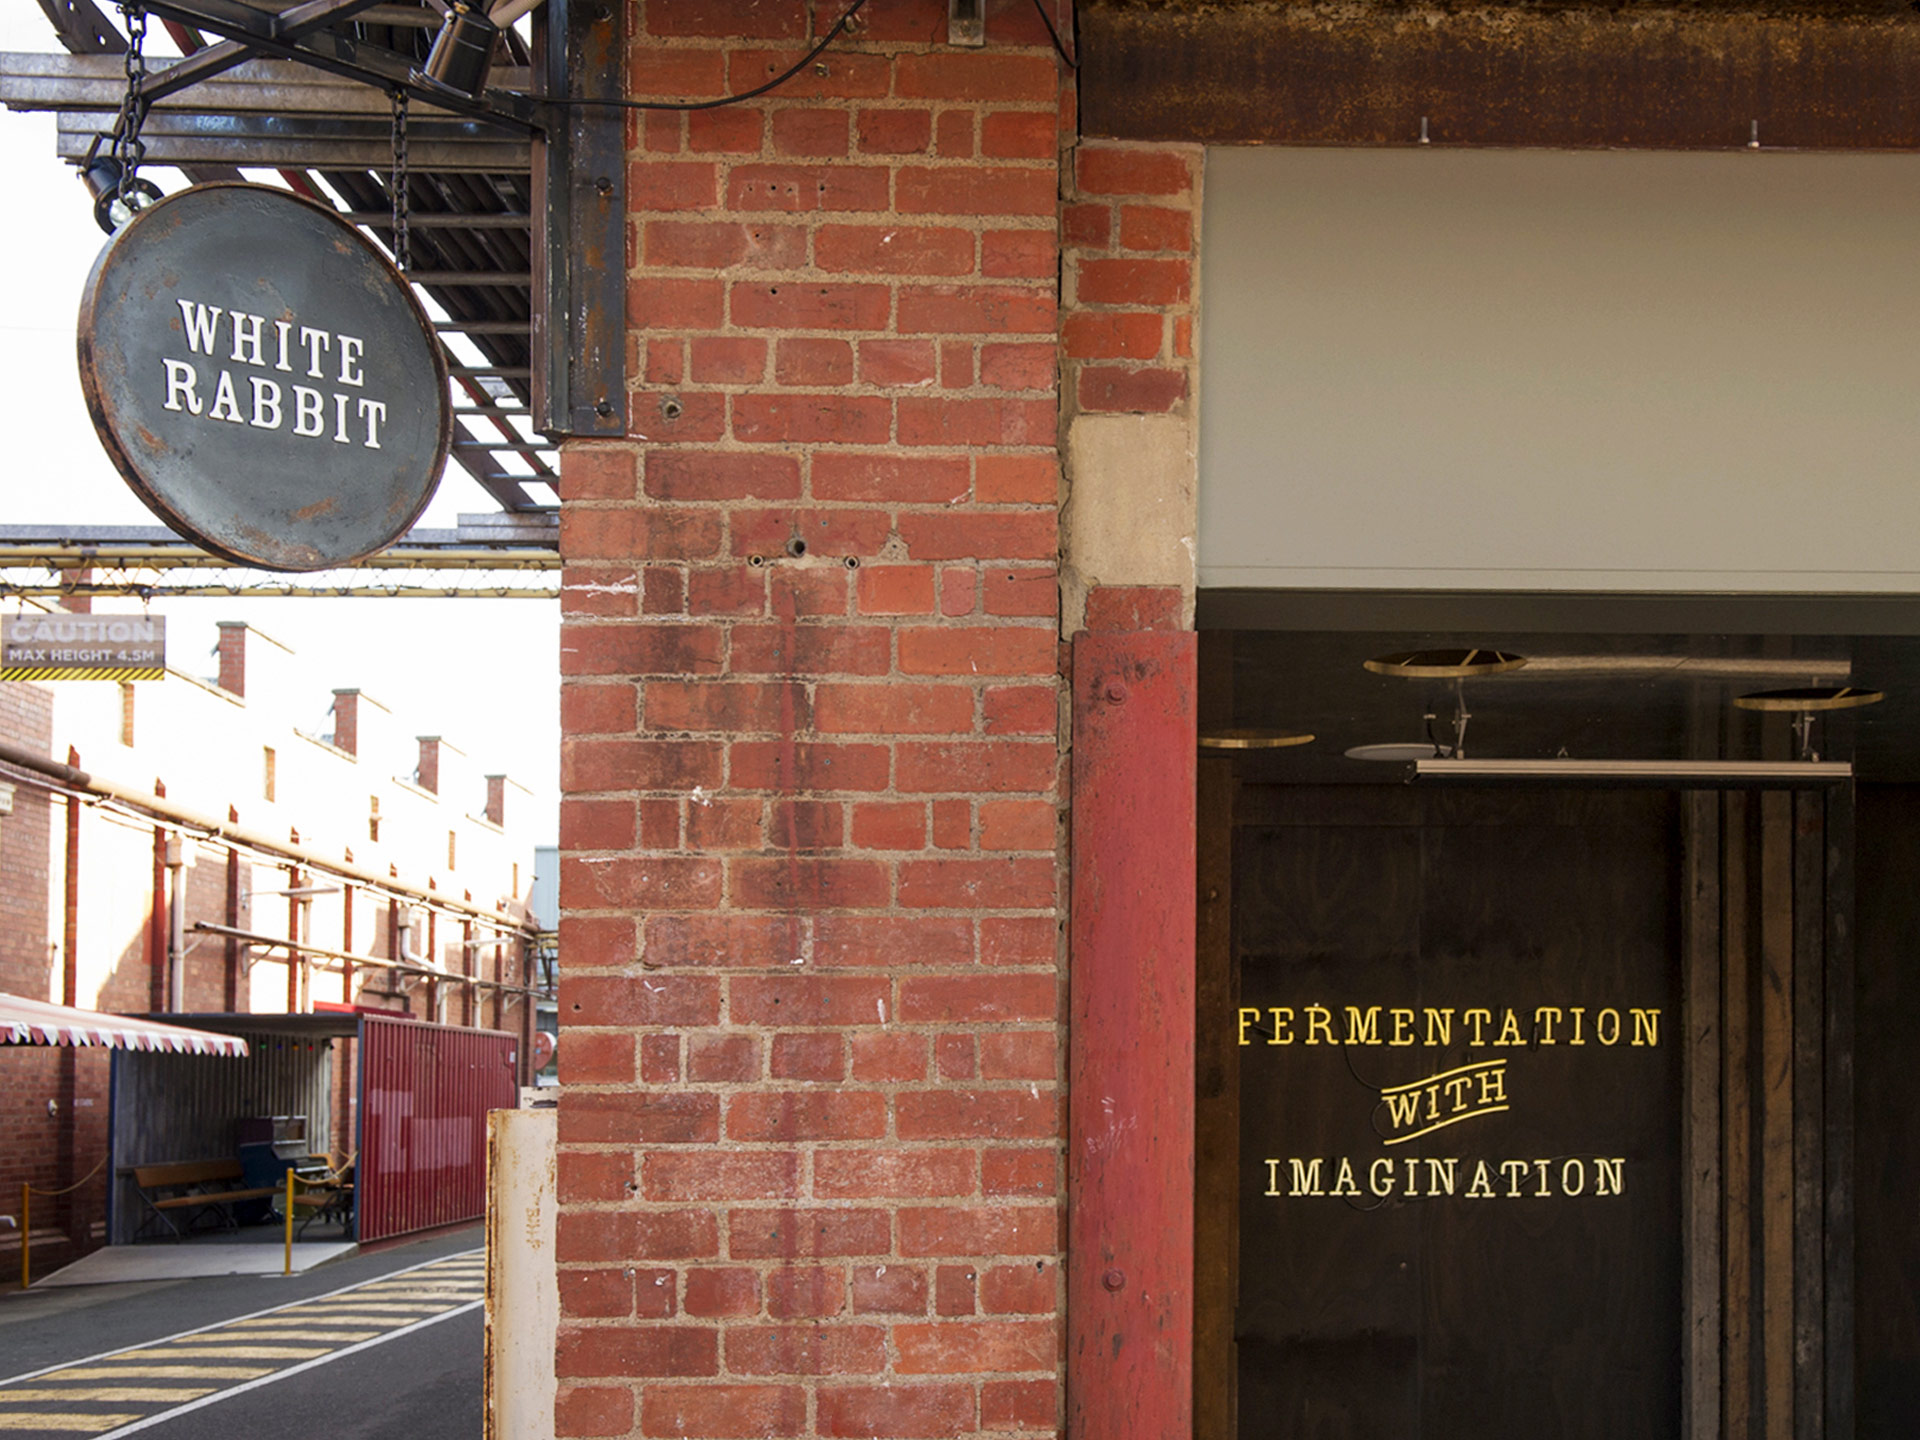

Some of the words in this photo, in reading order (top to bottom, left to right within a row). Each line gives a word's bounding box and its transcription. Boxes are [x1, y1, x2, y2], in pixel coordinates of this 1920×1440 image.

[177, 298, 365, 387] WHITE
[161, 357, 387, 449] RABBIT
[10, 621, 155, 643] CAUTION
[9, 649, 46, 661] MAX
[51, 649, 113, 661] HEIGHT
[117, 649, 155, 661] 4.5M
[1238, 1006, 1661, 1047] FERMENTATION
[1382, 1068, 1508, 1129] WITH
[1264, 1157, 1626, 1199] IMAGINATION
